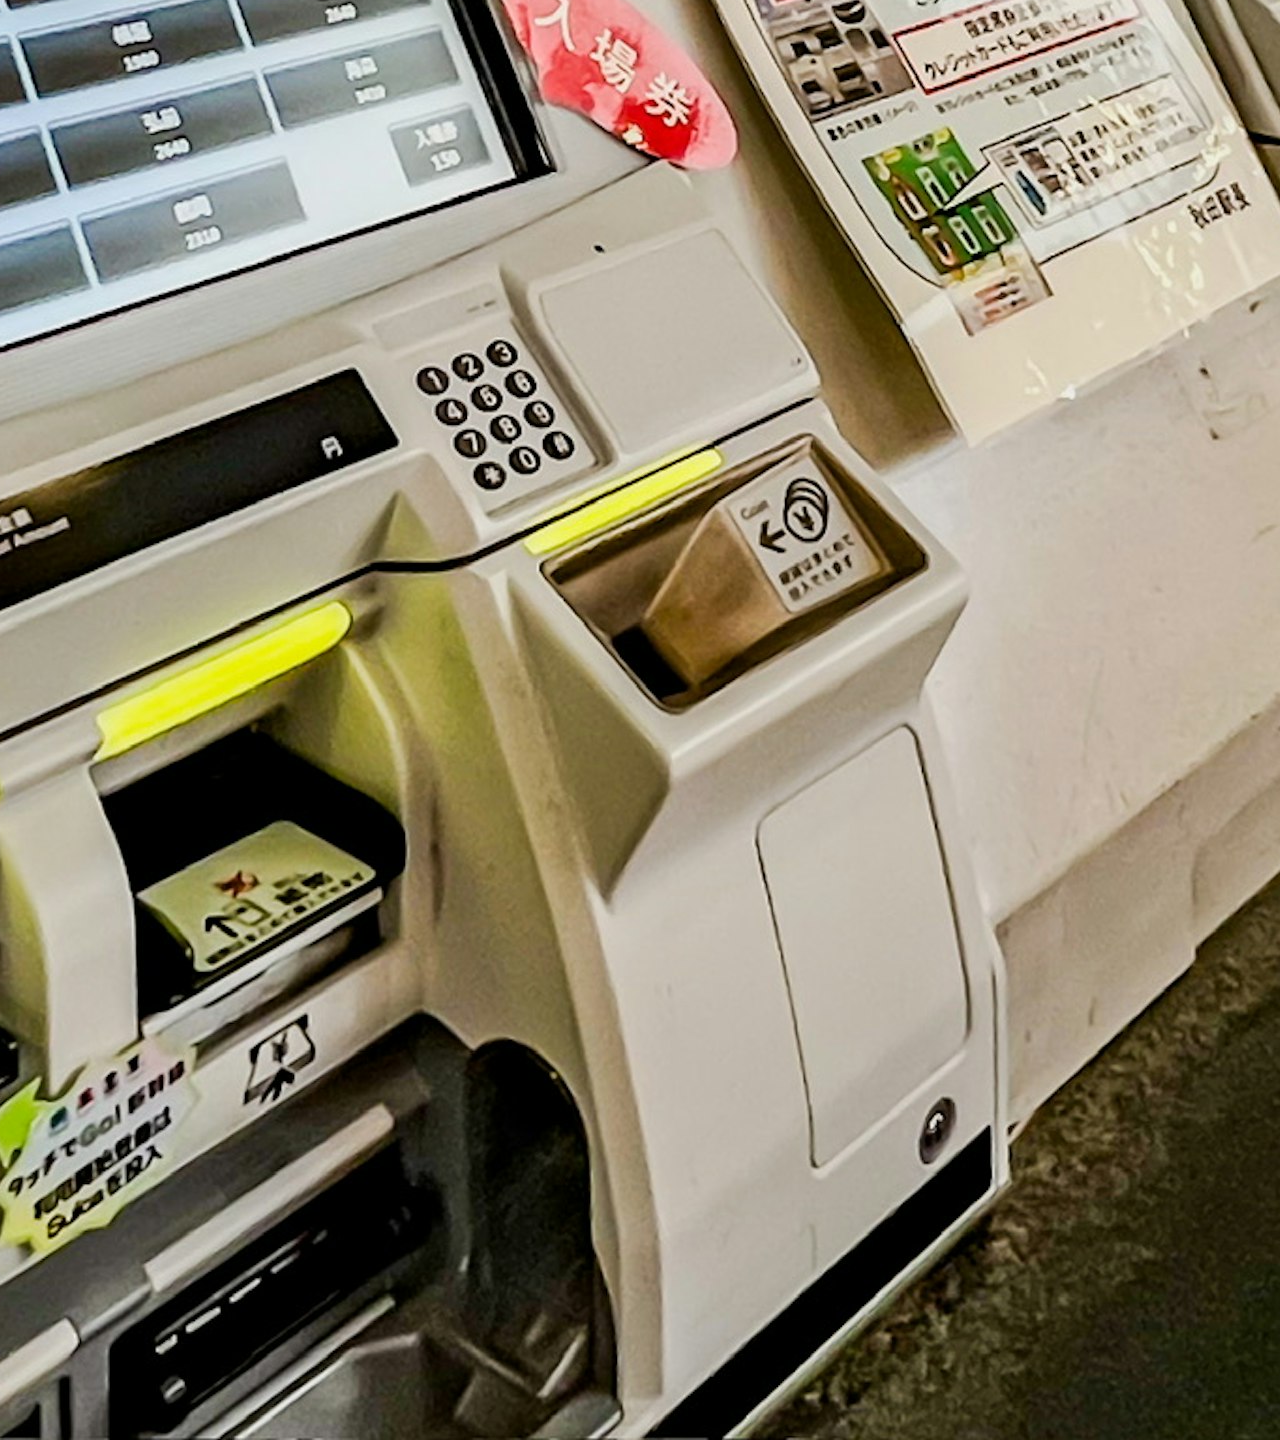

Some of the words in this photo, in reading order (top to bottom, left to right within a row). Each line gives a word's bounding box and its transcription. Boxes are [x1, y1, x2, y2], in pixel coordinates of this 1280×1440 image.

[427, 371, 443, 391] 1
[461, 356, 479, 376] 2
[495, 343, 512, 362] 3
[447, 402, 462, 420] 4
[514, 372, 531, 393] 6
[463, 433, 479, 453] 7
[498, 417, 517, 438] 8
[532, 404, 550, 423] 9
[519, 449, 536, 469] 0
